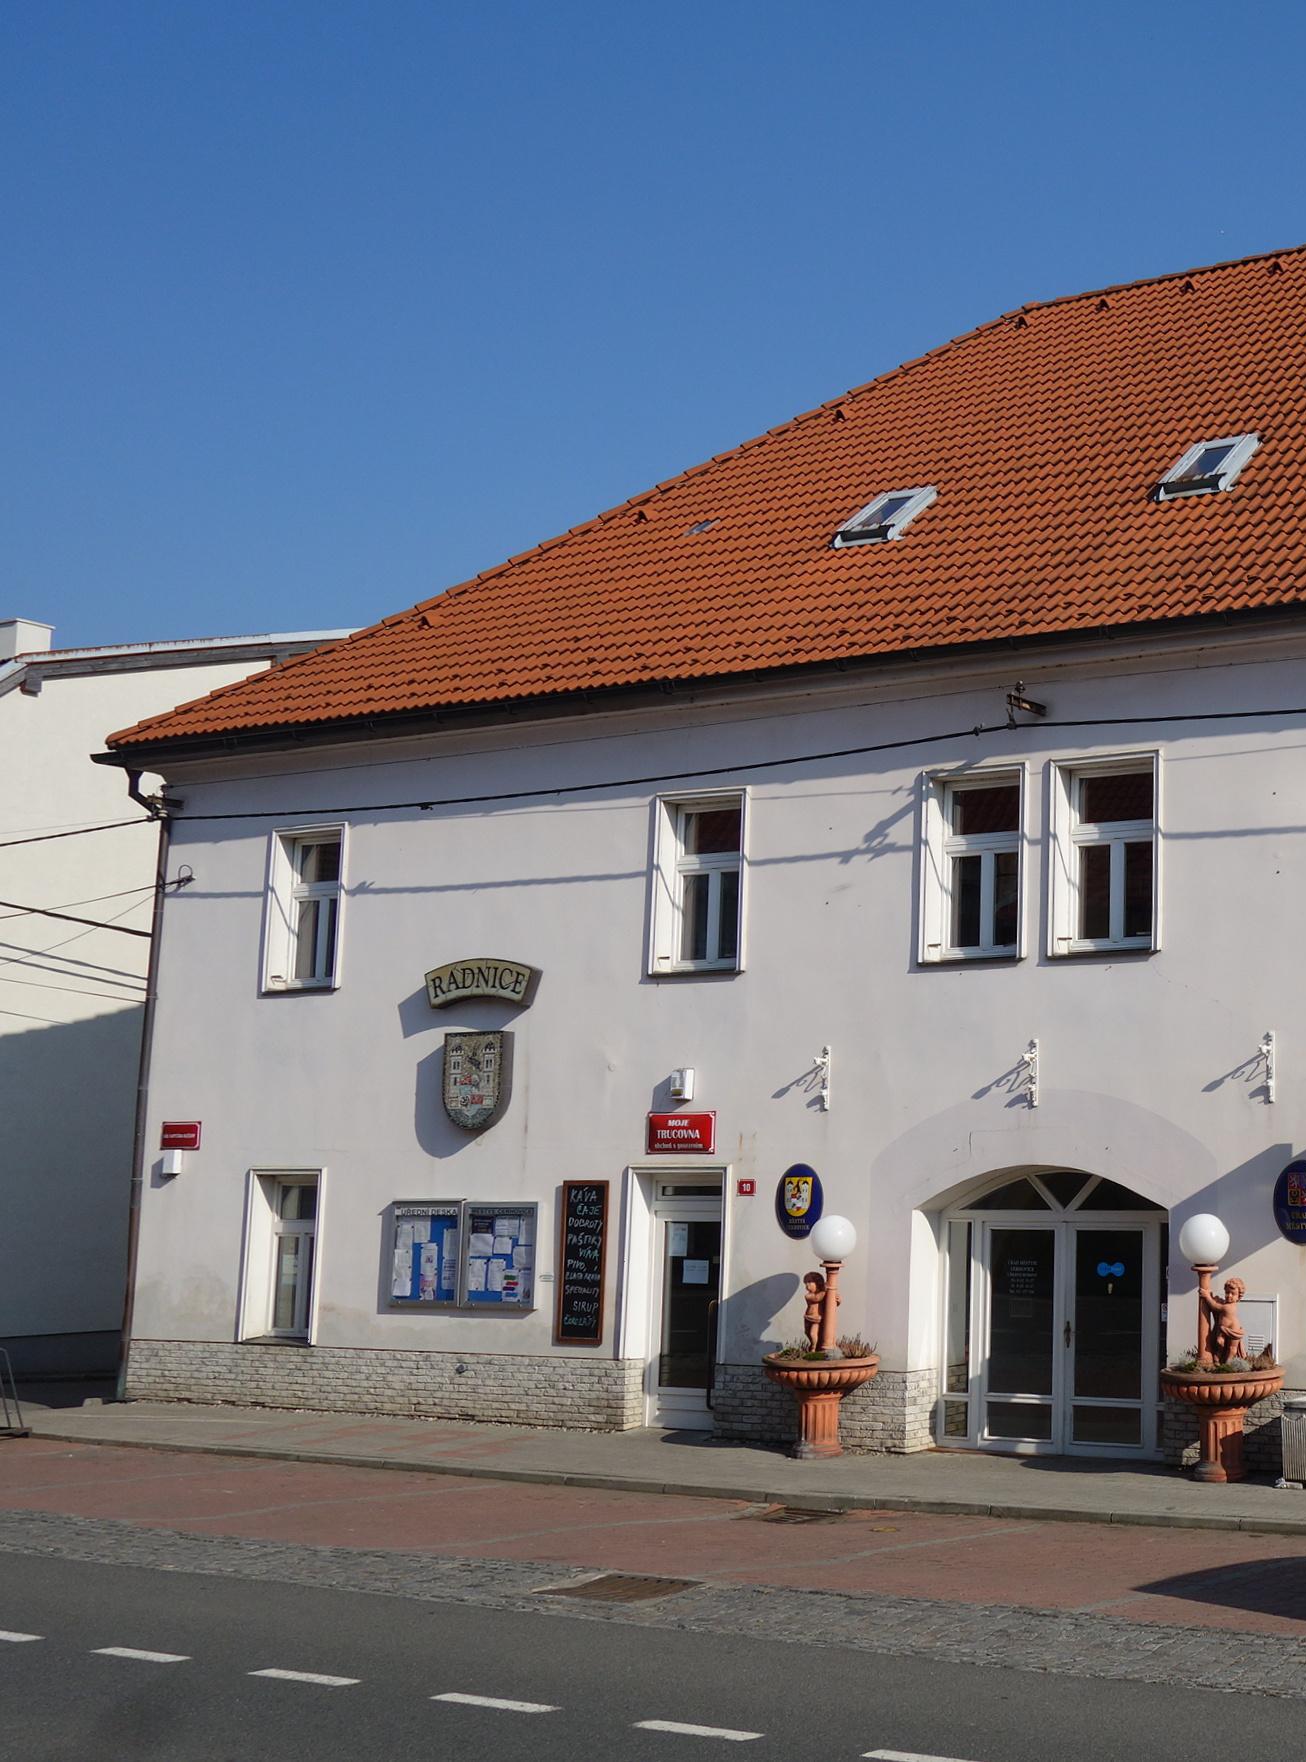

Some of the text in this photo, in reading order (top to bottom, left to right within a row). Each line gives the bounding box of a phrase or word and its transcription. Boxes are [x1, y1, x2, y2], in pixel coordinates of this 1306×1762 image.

[431, 966, 525, 999] RADNICE
[667, 1119, 689, 1127] MOJE
[656, 1129, 701, 1139] TRUCOVNA
[570, 1186, 597, 1202] KÁVA
[742, 1183, 751, 1192] 10
[431, 1208, 457, 1216] DESKA
[576, 1203, 602, 1216] ČAJE
[568, 1217, 603, 1232] DOBROTY
[579, 1246, 600, 1261] VÍNA
[573, 1301, 599, 1314] SIRUP
